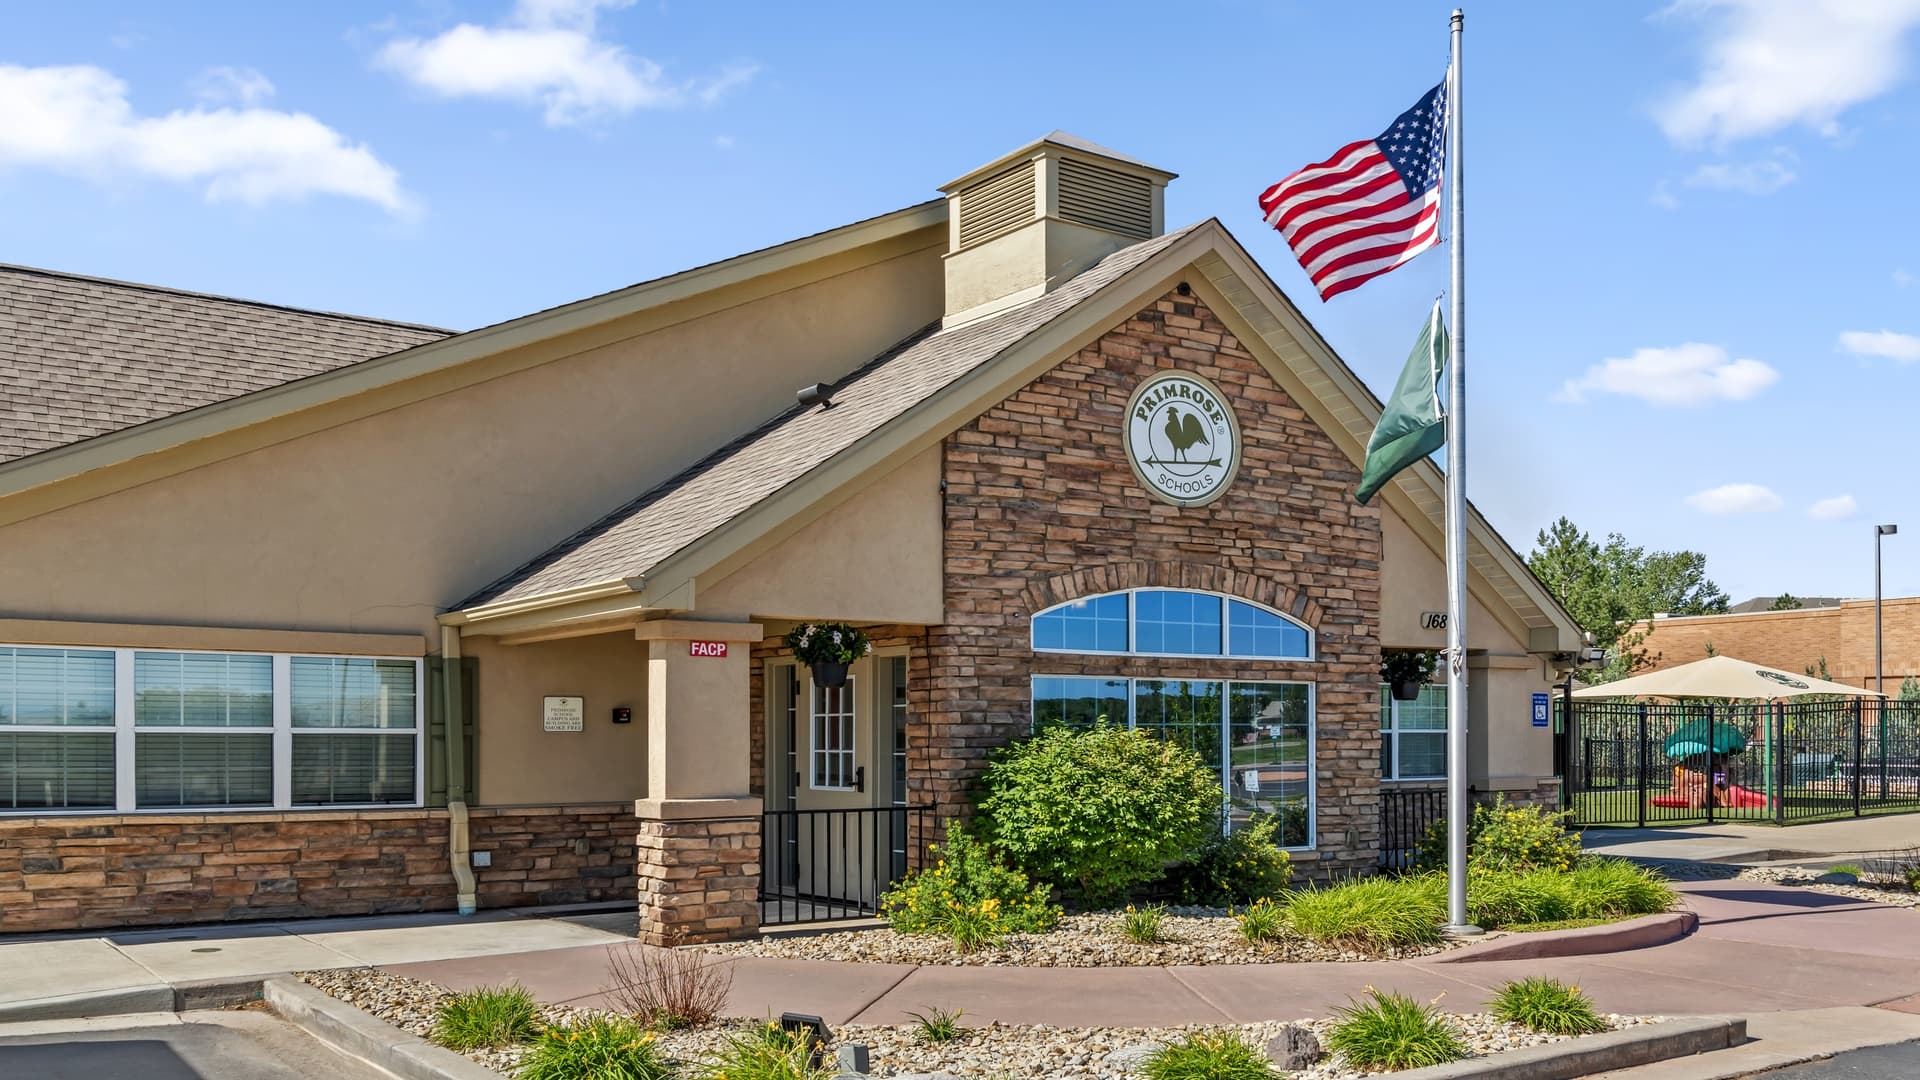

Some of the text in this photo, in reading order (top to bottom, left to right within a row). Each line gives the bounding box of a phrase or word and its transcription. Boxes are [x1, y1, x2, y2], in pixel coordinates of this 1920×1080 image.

[1135, 383, 1223, 425] PRIMROSE
[1158, 473, 1214, 494] SCHOOLS
[691, 642, 726, 656] FACP
